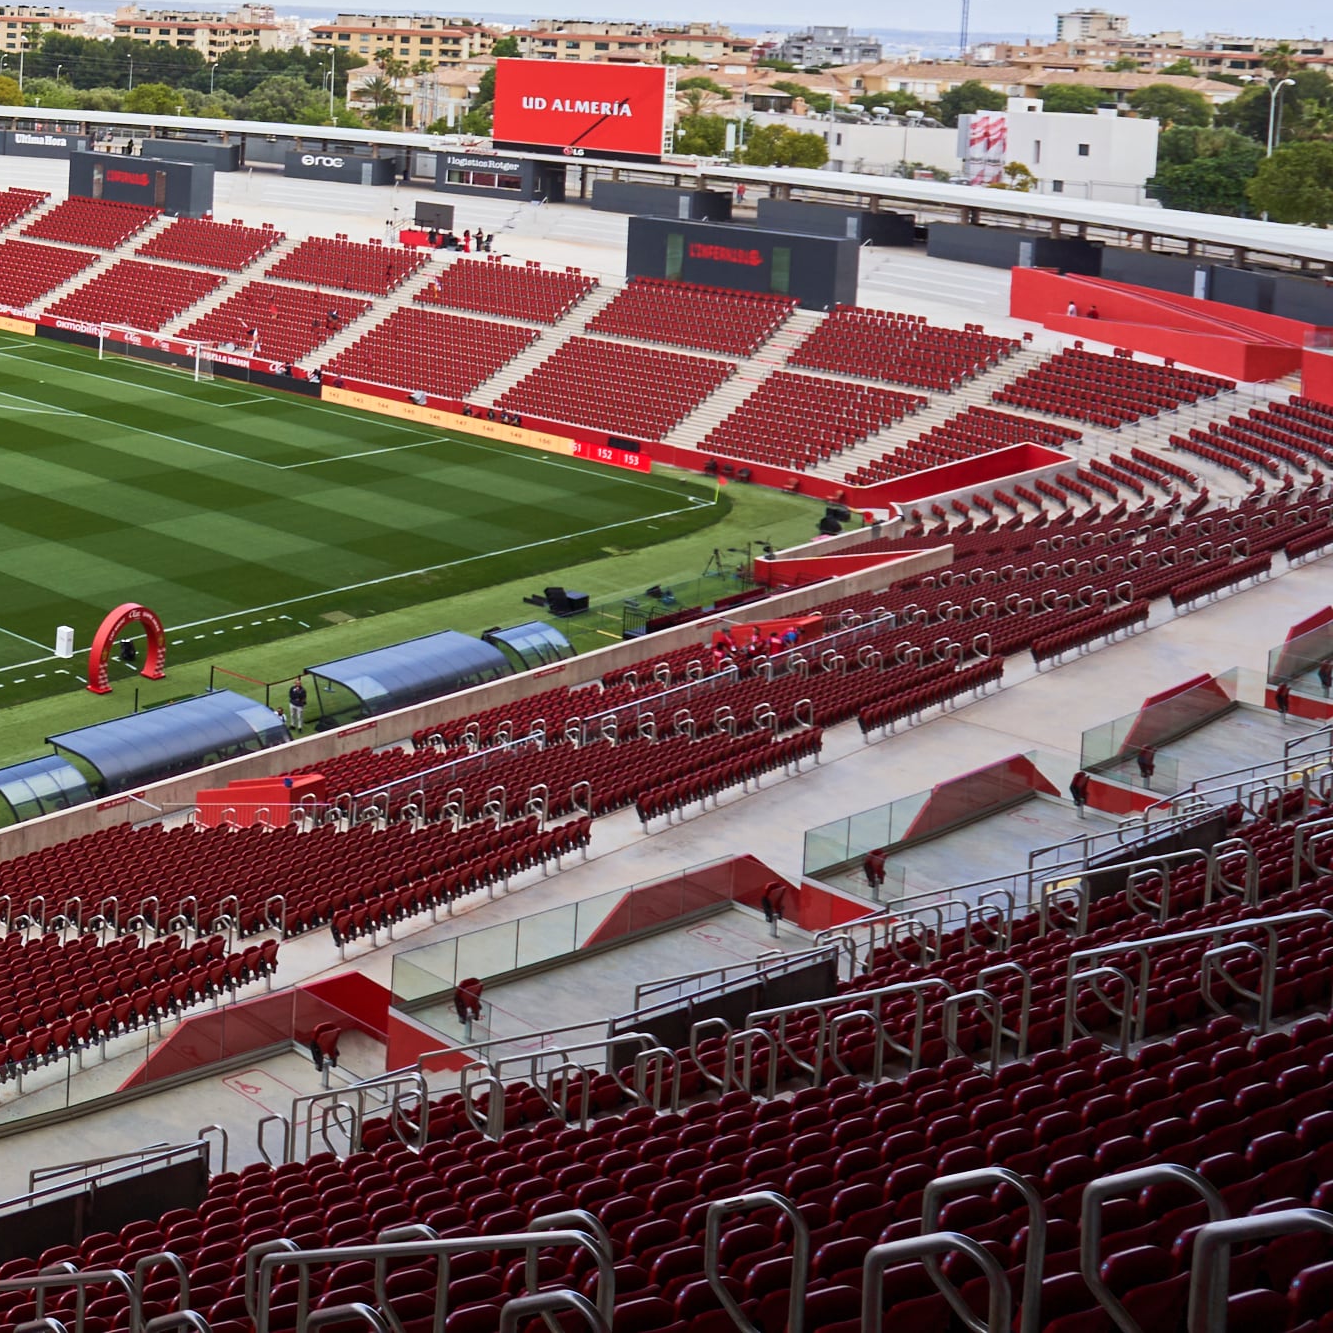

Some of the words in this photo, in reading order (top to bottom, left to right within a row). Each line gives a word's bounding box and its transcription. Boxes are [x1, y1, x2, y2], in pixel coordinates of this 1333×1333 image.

[522, 96, 547, 110] UD
[551, 99, 633, 117] ALMERÍA
[45, 135, 67, 147] Hora
[572, 148, 585, 156] LG
[597, 448, 613, 460] 152
[624, 454, 639, 466] 153
